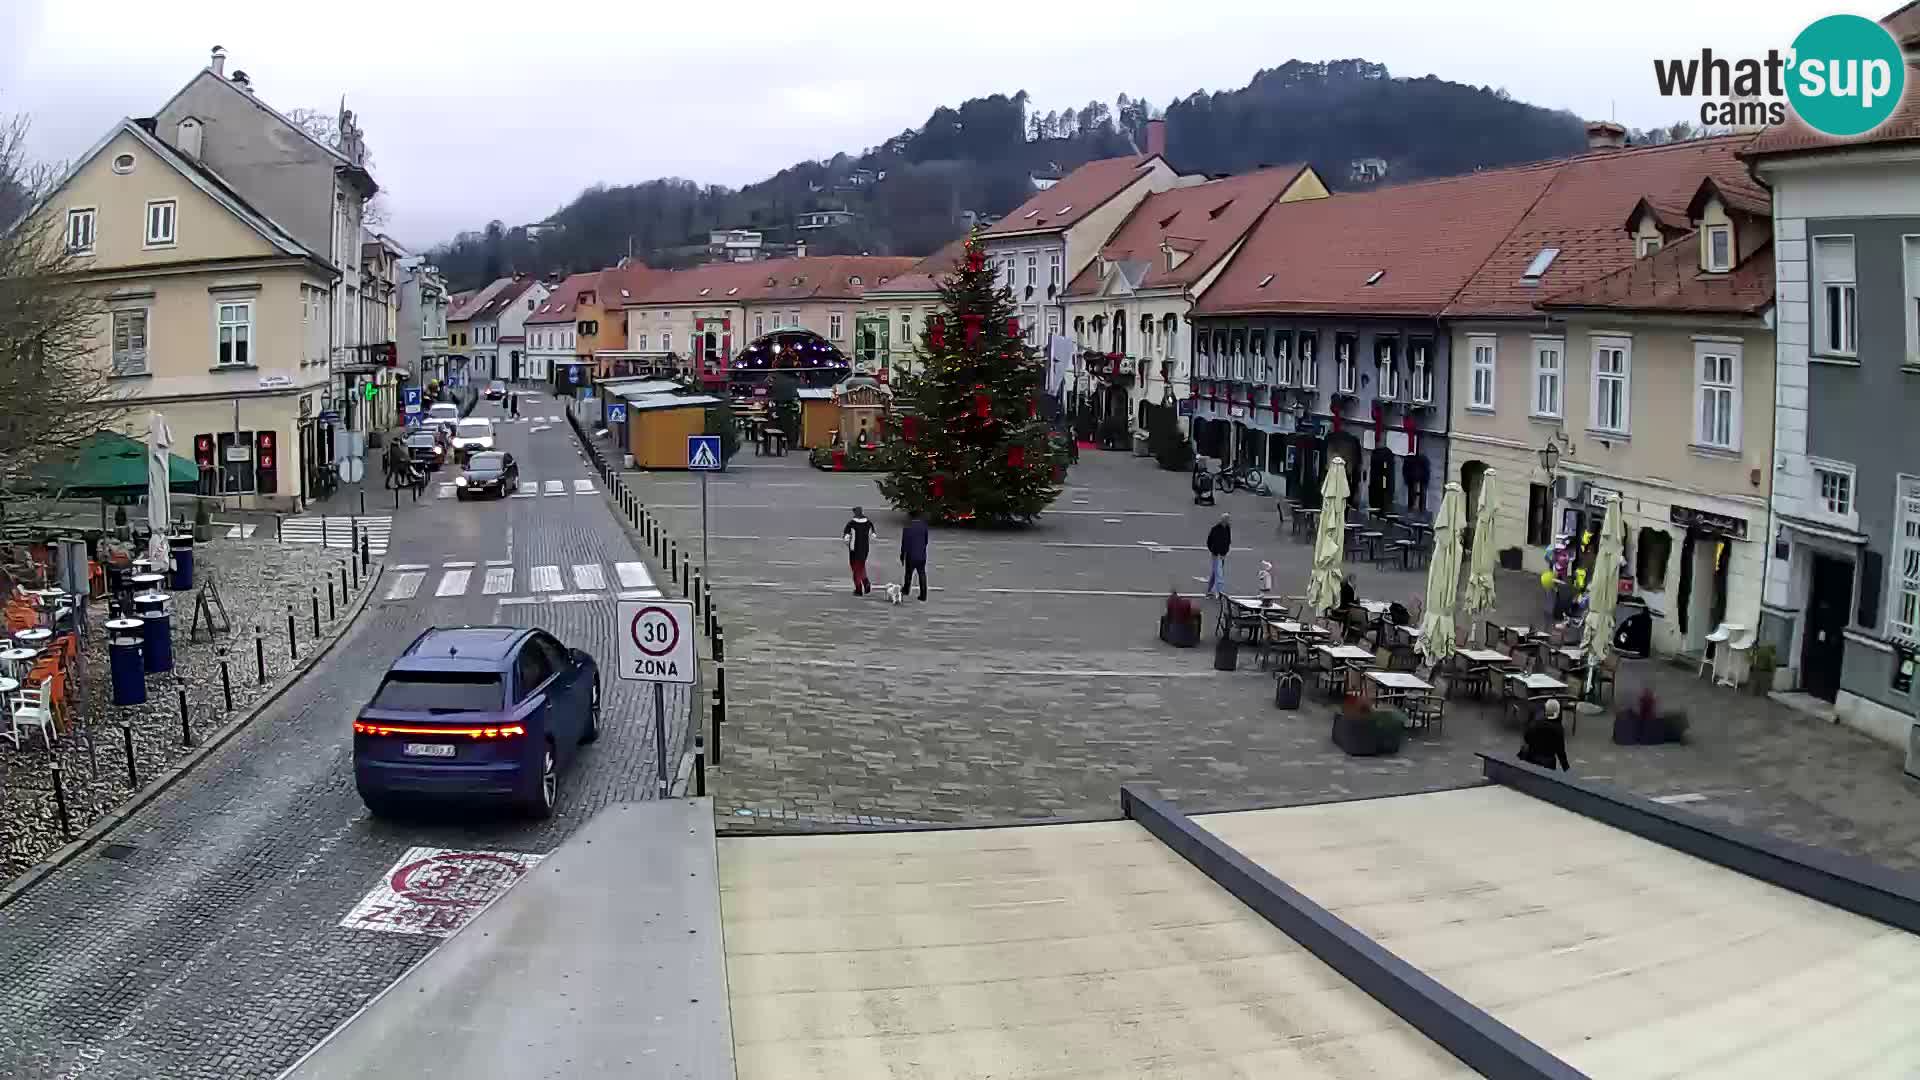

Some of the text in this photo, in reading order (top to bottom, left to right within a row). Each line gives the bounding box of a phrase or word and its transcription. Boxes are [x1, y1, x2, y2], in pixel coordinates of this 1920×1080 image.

[409, 391, 416, 402] P
[643, 622, 668, 643] 30
[634, 659, 679, 677] ZONA
